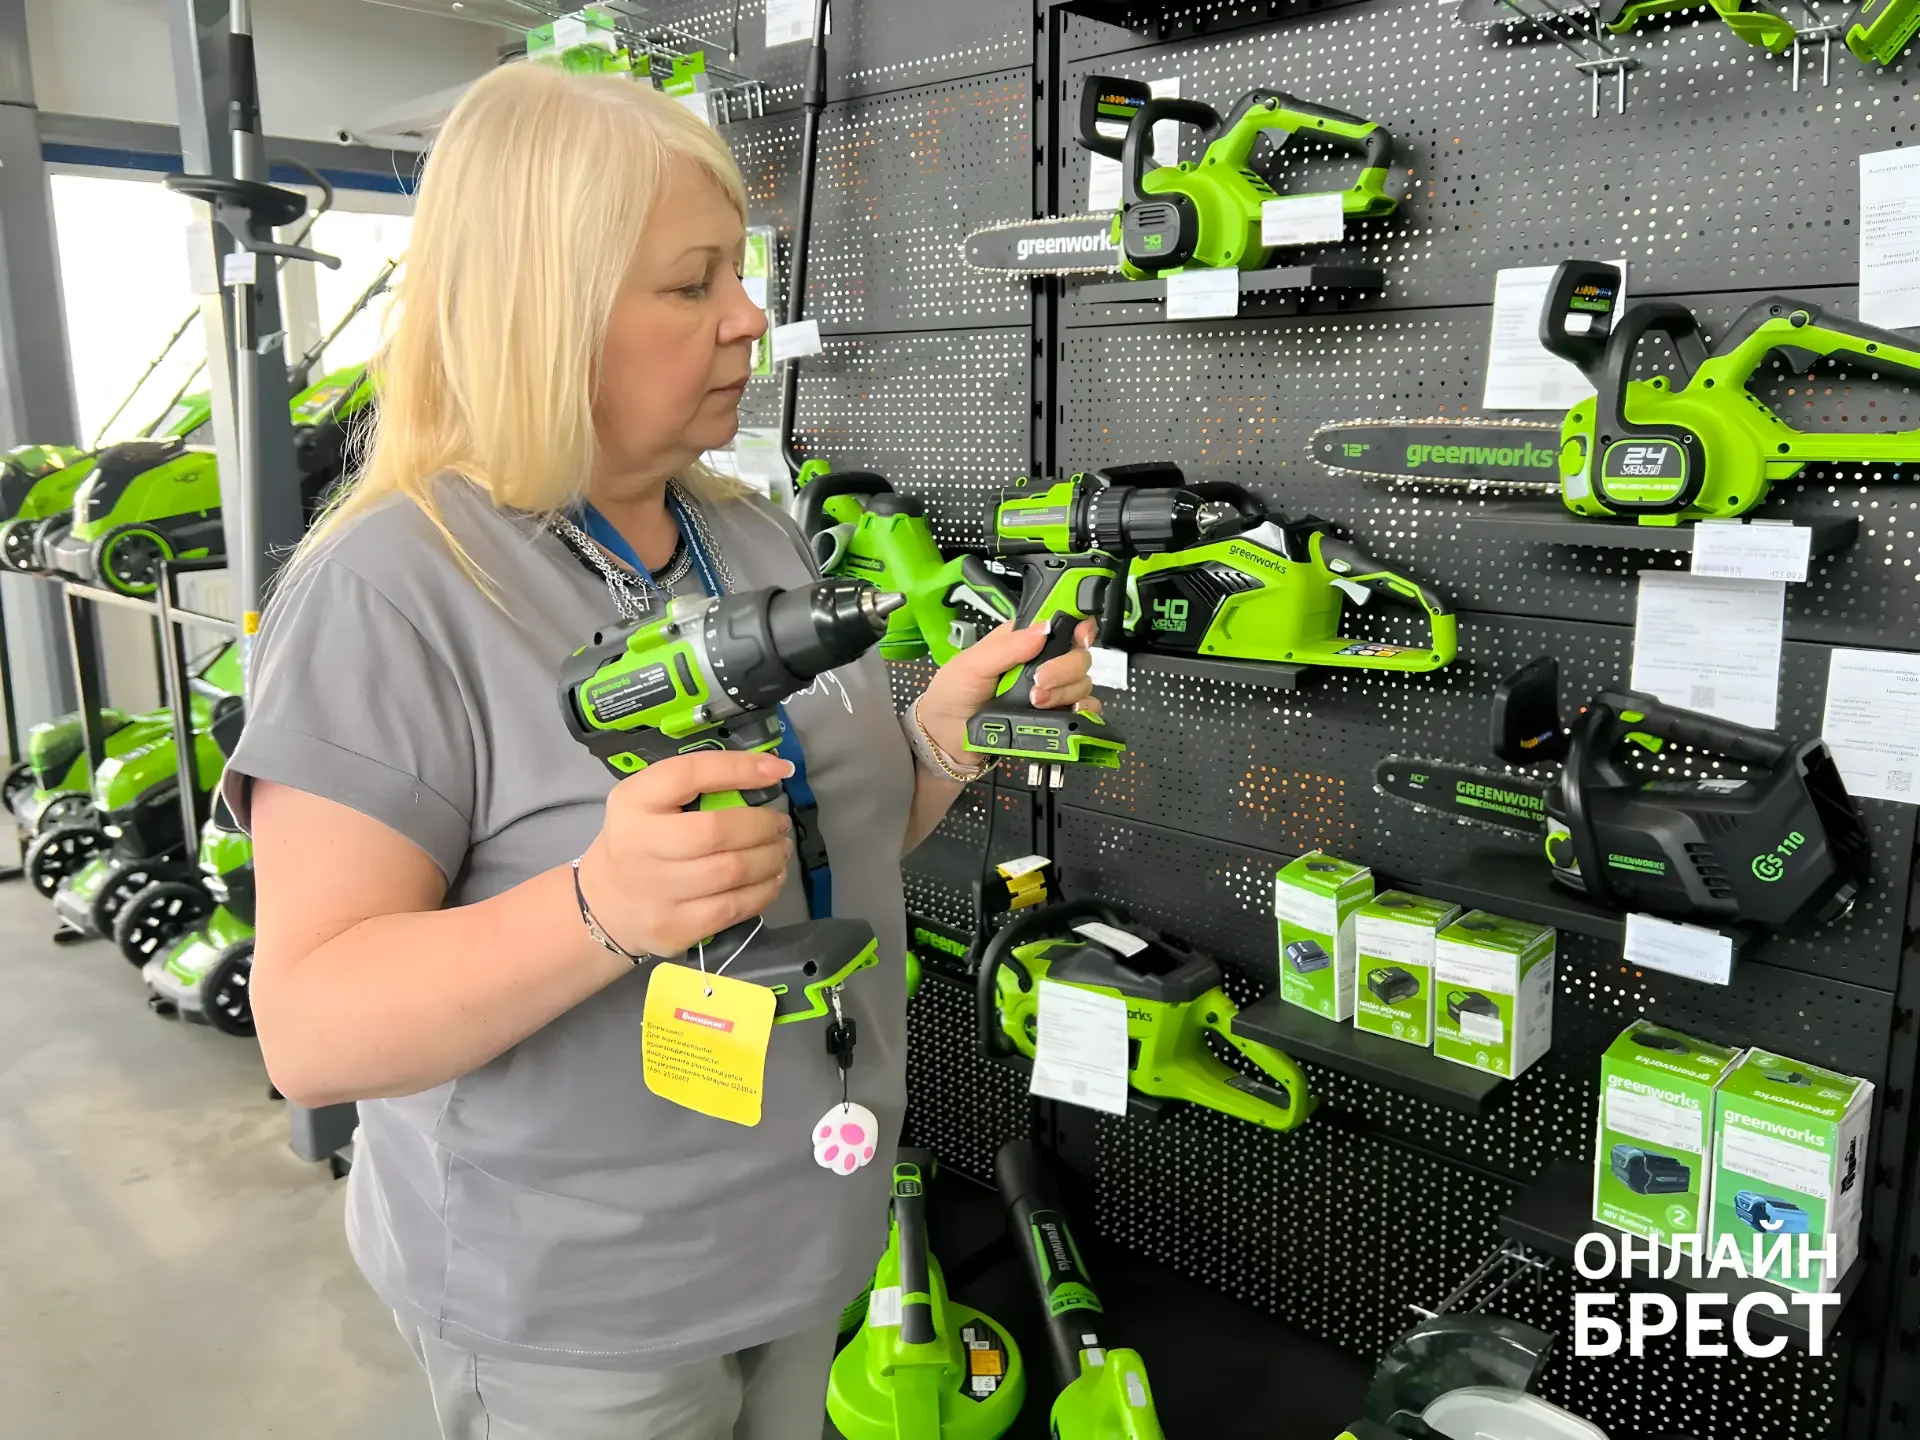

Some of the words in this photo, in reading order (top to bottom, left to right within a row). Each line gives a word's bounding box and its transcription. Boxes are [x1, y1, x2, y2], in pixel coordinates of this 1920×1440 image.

[1406, 441, 1554, 468] greenworks
[1623, 447, 1668, 465] 24
[1229, 544, 1287, 574] greenworks
[1153, 598, 1189, 620] 40
[713, 658, 725, 668] 7
[727, 686, 739, 695] 9
[1478, 801, 1530, 819] COMMERCIAL
[1777, 831, 1805, 856] 110
[1608, 853, 1665, 870] GREENWORKS
[682, 1011, 725, 1030] Внимание!
[1359, 1000, 1380, 1010] HIGH
[1380, 1005, 1411, 1019] POWER
[1635, 1055, 1711, 1080] greenworks
[1608, 1074, 1699, 1109] greenworks
[1753, 1090, 1837, 1116] greenworks
[1724, 1110, 1825, 1147] greenworks
[1673, 1210, 1686, 1226] 2
[1041, 1223, 1072, 1271] greenworks
